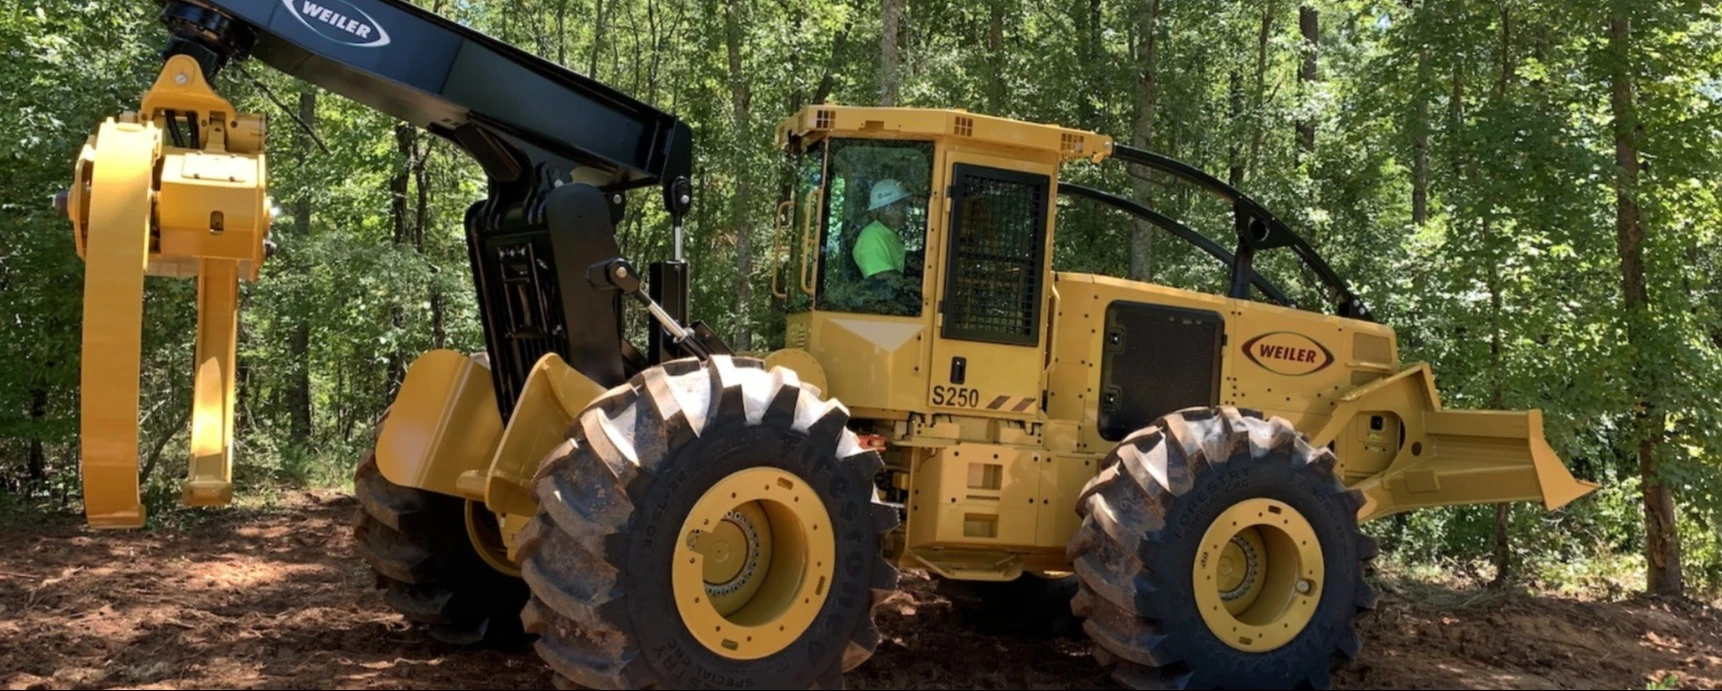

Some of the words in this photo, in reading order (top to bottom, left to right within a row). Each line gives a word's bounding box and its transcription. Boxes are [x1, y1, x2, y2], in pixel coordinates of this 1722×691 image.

[302, 1, 371, 38] WEILER
[1260, 344, 1316, 363] WEILER
[932, 385, 979, 408] S250
[1173, 467, 1249, 538] FORESTRY
[667, 638, 691, 666] CRC
[697, 664, 755, 688] SPECIAL
